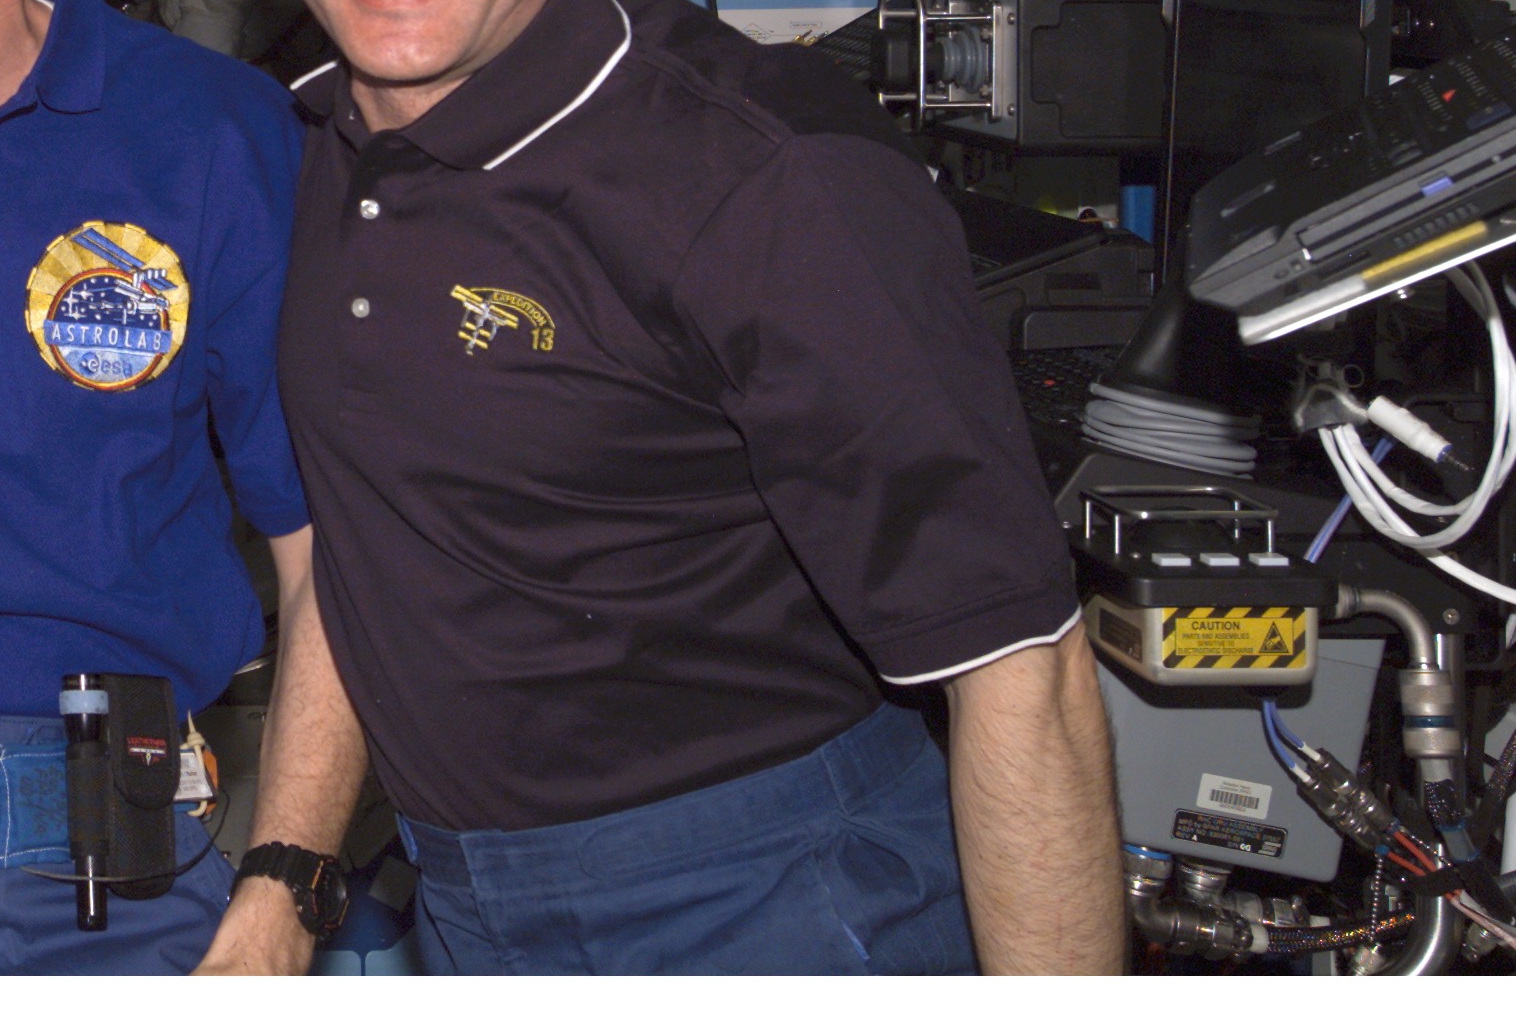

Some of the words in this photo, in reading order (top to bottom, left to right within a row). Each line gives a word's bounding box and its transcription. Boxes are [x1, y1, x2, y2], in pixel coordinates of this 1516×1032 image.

[493, 292, 547, 327] EXPEDITION
[51, 323, 163, 351] ASTROLAB
[531, 328, 555, 351] 13
[1191, 621, 1241, 631] CAUTION
